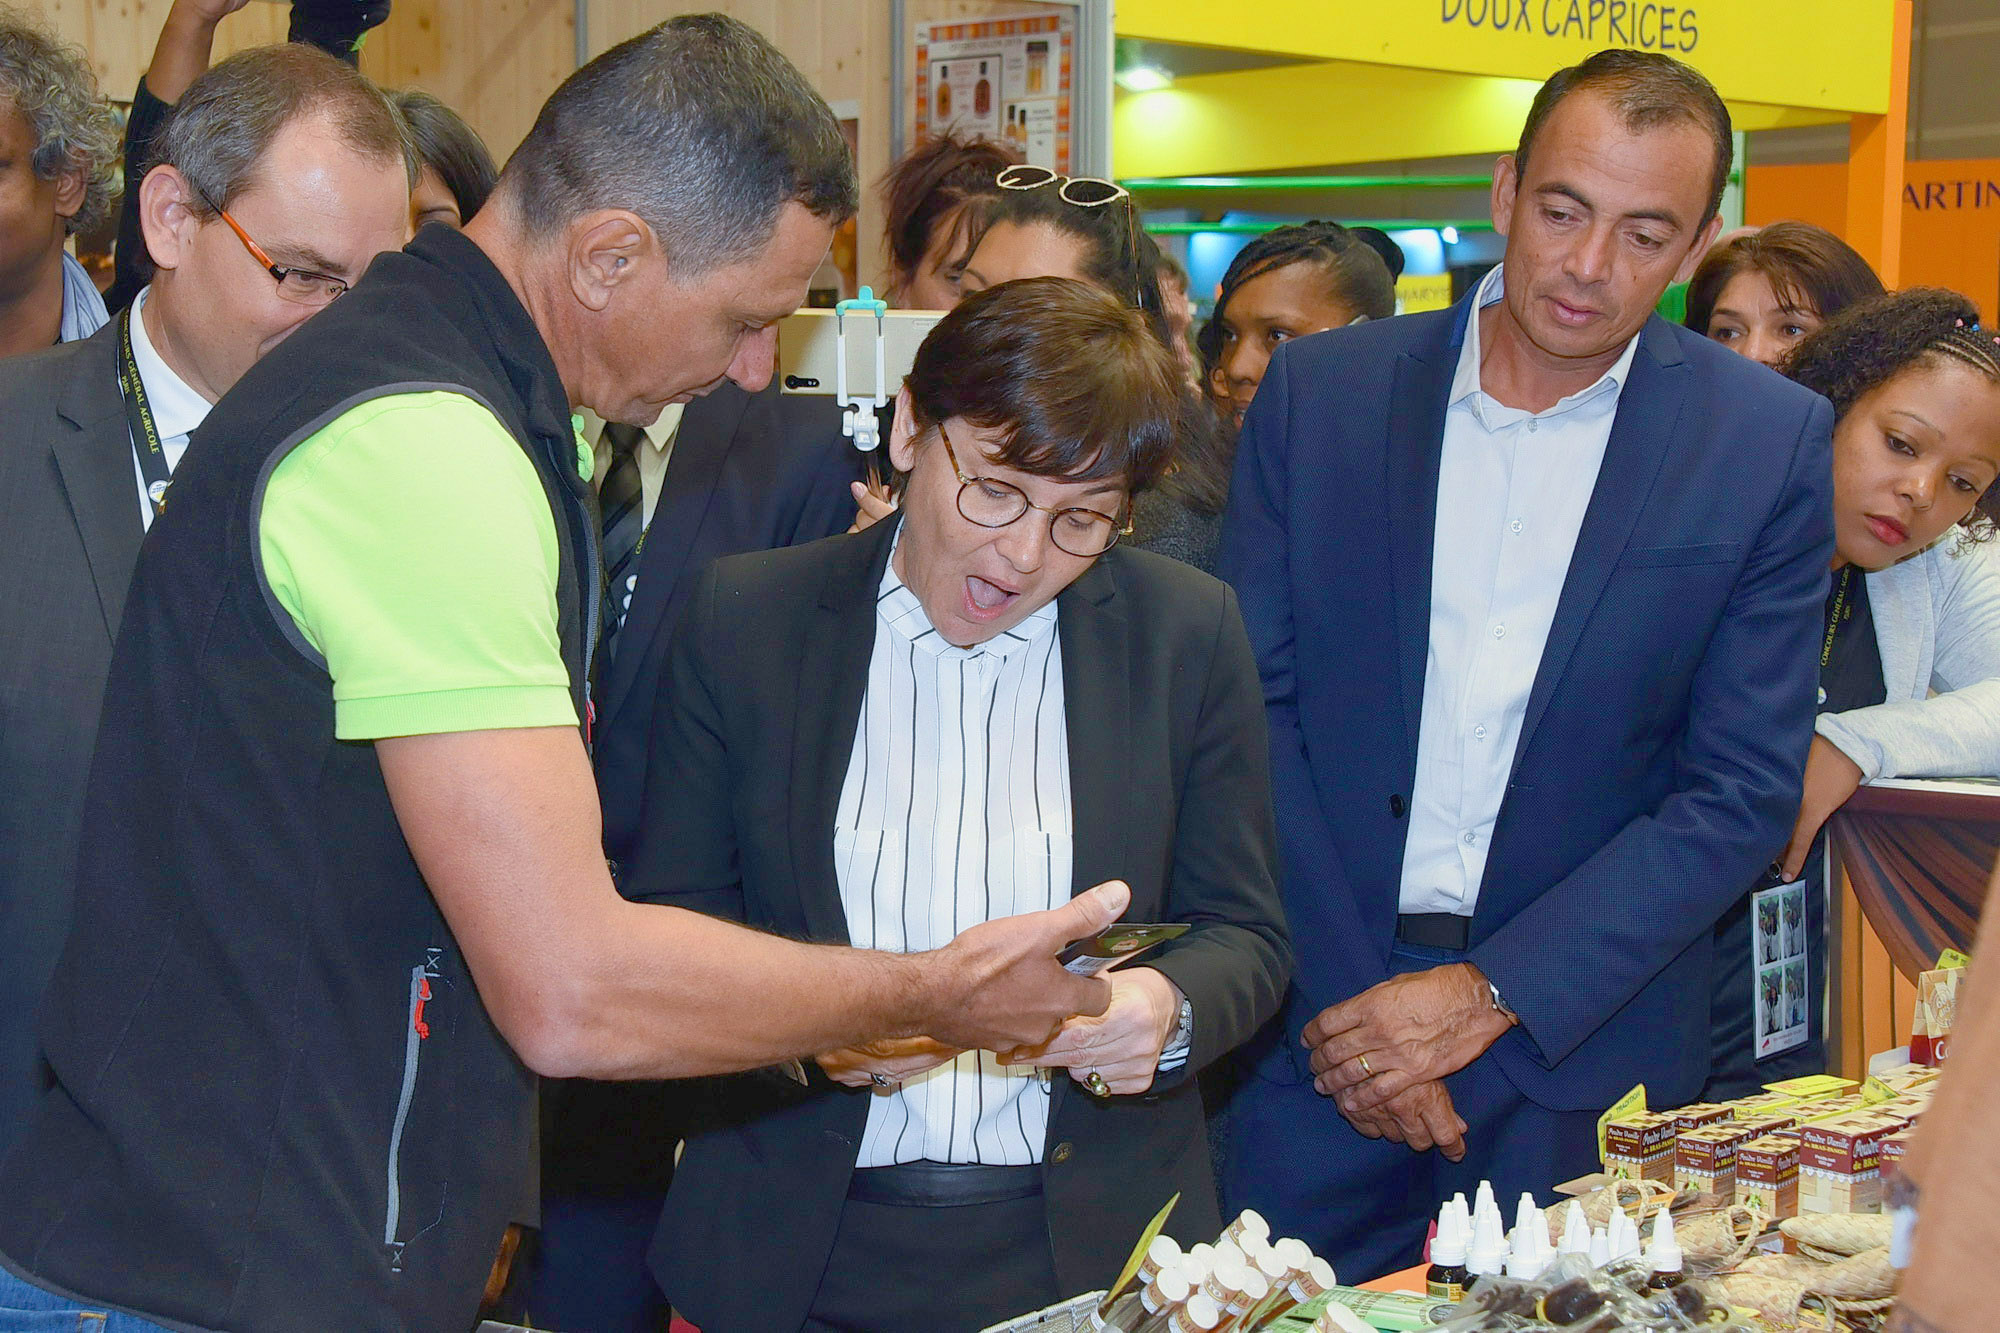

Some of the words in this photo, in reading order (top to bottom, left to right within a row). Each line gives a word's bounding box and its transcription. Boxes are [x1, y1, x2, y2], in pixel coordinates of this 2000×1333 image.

[1441, 0, 1531, 33] DOUX
[1542, 0, 1699, 52] CAPRICES
[140, 407, 160, 455] AGRICOLE
[1820, 624, 1837, 666] CONCOURS
[1642, 1130, 1661, 1147] Poudre
[1803, 1131, 1826, 1145] Poudre
[1826, 1136, 1850, 1150] Vanille
[1714, 1143, 1732, 1160] Poudre
[1811, 1143, 1848, 1156] BRAS-PANON
[1852, 1160, 1861, 1171] de
